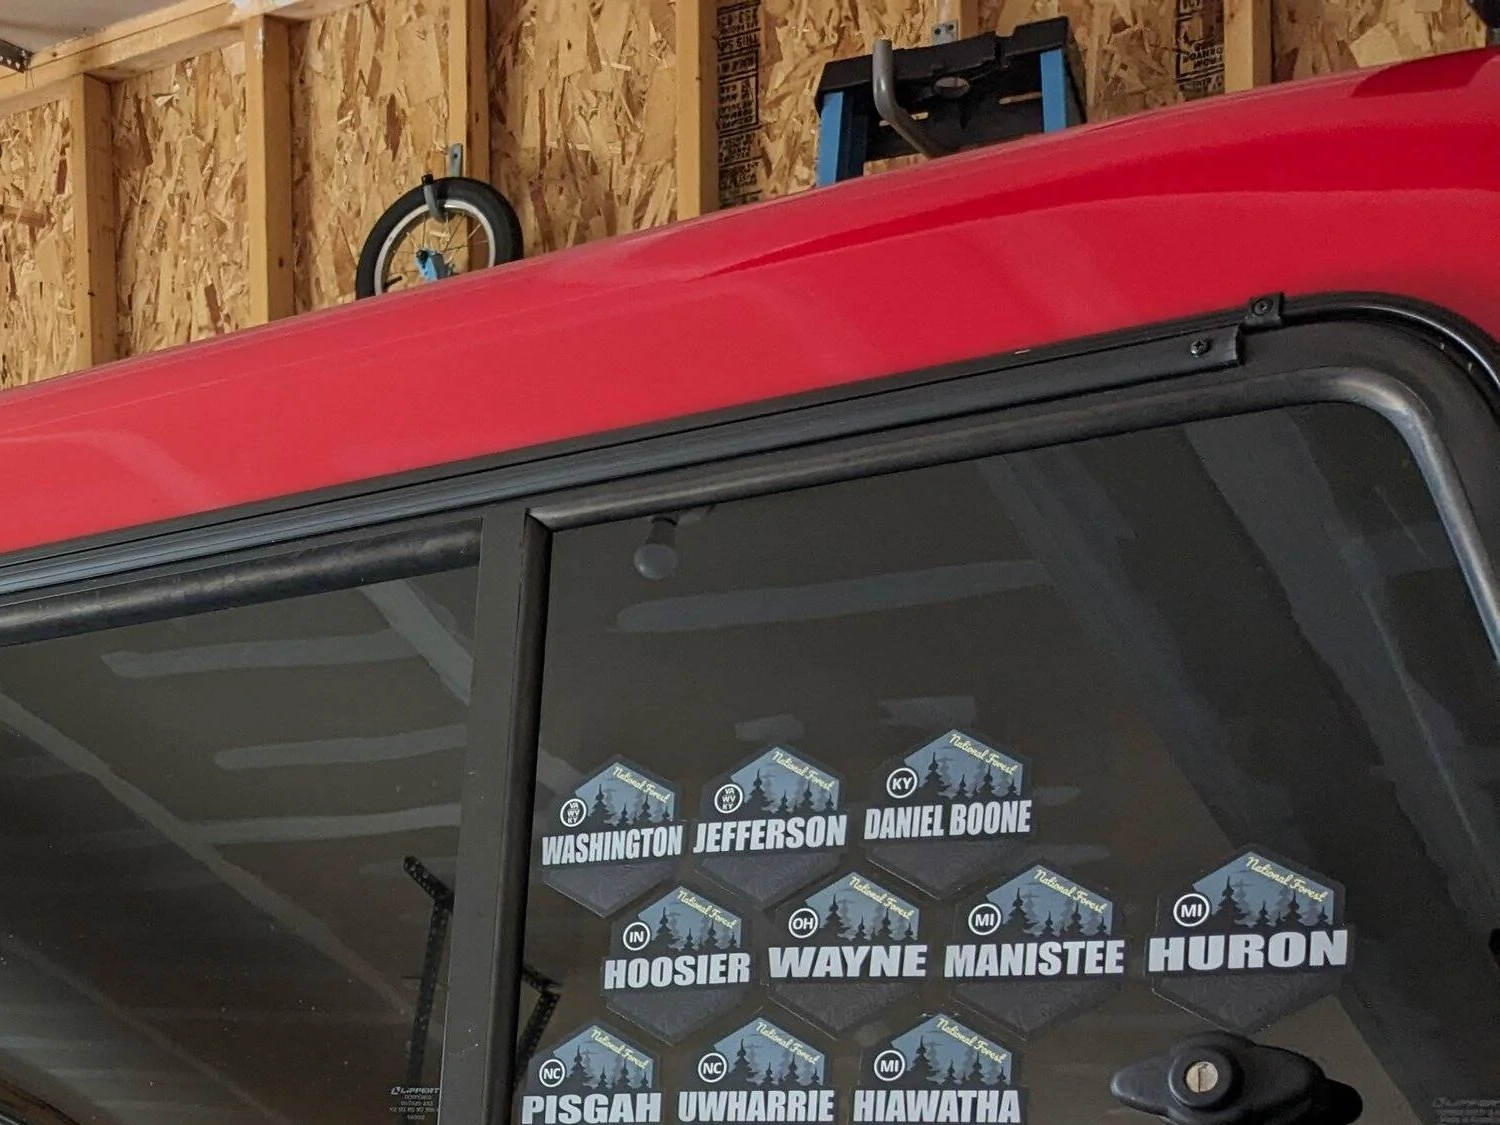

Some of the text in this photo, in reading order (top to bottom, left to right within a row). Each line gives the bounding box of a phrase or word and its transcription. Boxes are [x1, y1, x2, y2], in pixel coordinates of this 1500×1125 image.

[772, 751, 835, 791] National Forest
[950, 733, 1019, 775] National Forest
[613, 766, 670, 803] National Forest
[892, 777, 913, 790] KY
[693, 814, 847, 853] JEFFERSON
[864, 800, 1032, 840] DANIEL BOONE
[542, 825, 683, 865] WASHINGTON
[1033, 869, 1107, 914] National Forest
[1245, 856, 1329, 902] National Forest
[677, 890, 737, 929] National Forest
[850, 876, 915, 920] National Forest
[1180, 903, 1202, 917] MI
[629, 931, 645, 943] IN
[792, 917, 814, 930] OH
[974, 913, 994, 927] MI
[768, 945, 928, 978] WAYNE
[944, 940, 1125, 978] MANISTEE
[1148, 929, 1348, 972] HURON
[604, 952, 750, 989] HOOSIER
[590, 1029, 649, 1070] National Forest
[756, 1021, 820, 1065] National Forest
[936, 1018, 1007, 1064] National Forest
[543, 1068, 561, 1080] NC
[703, 1062, 723, 1075] NC
[880, 1059, 899, 1072] MI
[521, 1092, 662, 1124] PISGAH
[678, 1090, 835, 1122] UWHARRIE
[853, 1089, 1021, 1123] HIAWATHA
